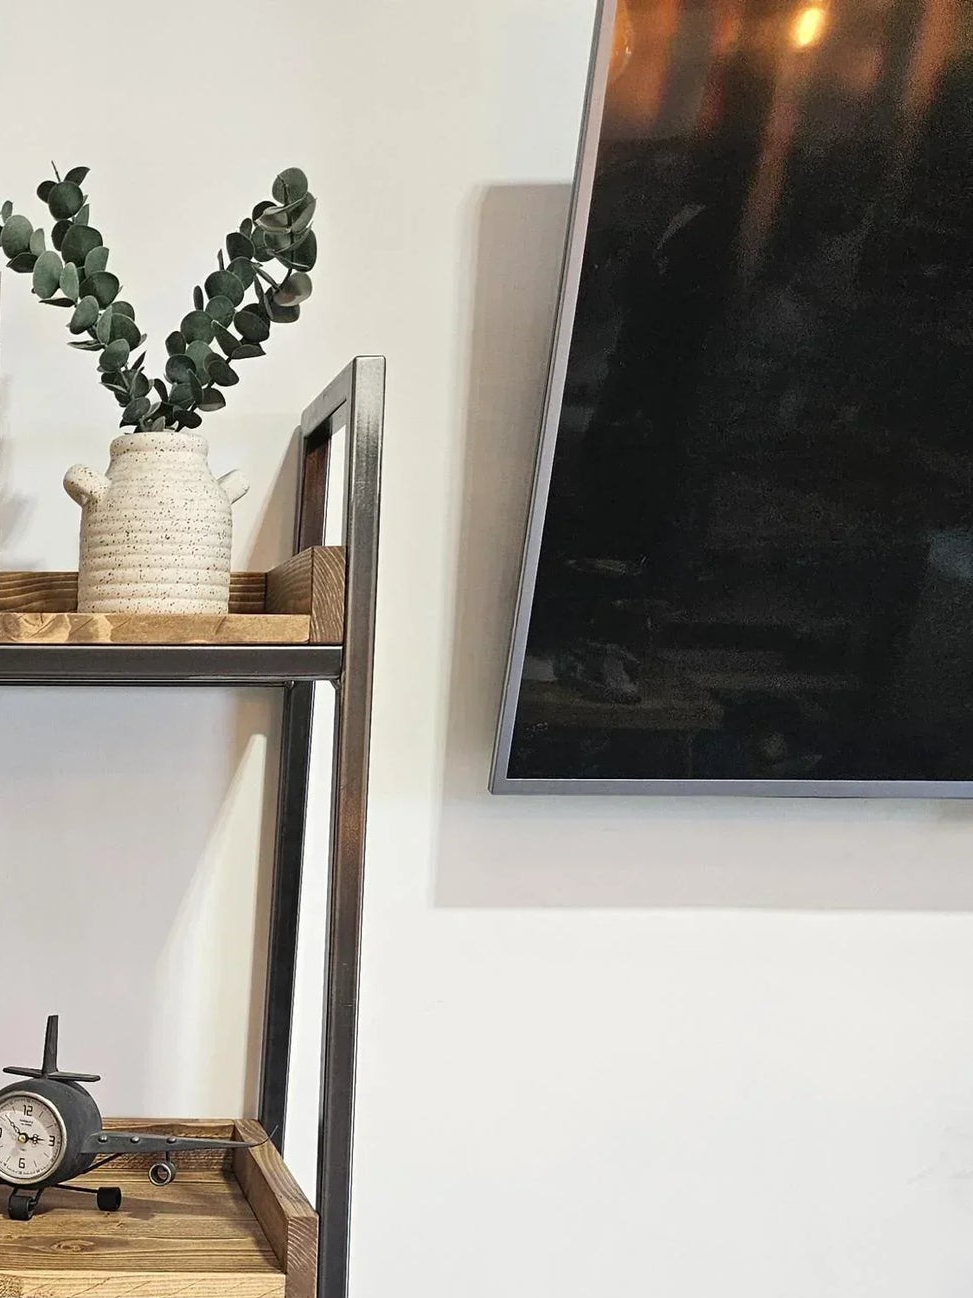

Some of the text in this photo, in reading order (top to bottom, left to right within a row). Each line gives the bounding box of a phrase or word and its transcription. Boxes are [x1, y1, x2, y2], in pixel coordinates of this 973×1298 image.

[23, 1104, 33, 1117] 12
[49, 1135, 56, 1147] 3
[18, 1157, 26, 1169] 6
